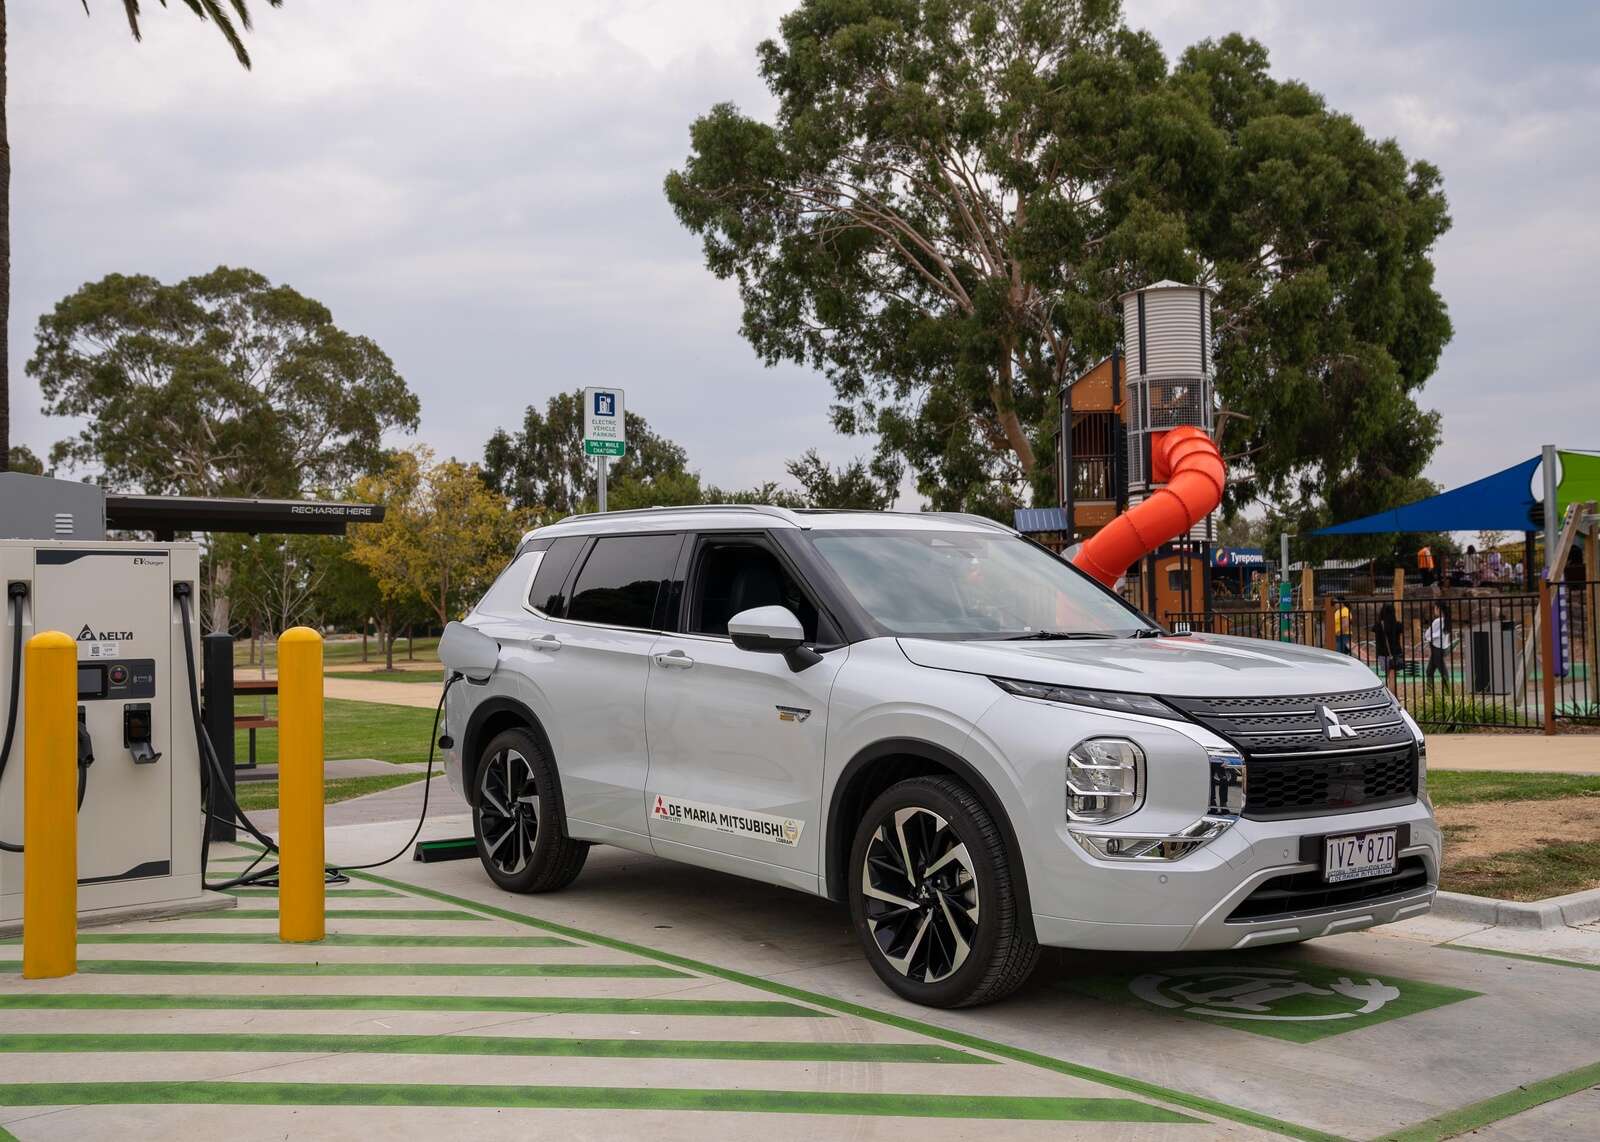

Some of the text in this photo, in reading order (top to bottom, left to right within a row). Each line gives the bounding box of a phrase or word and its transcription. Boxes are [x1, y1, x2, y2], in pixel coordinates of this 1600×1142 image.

[291, 506, 345, 515] RECHARGE
[99, 631, 133, 641] DELTA
[669, 804, 682, 818] DE
[683, 807, 718, 825] MARIA
[719, 813, 784, 838] MITSUBISHI
[1329, 835, 1394, 870] 1VZ 8ZD
